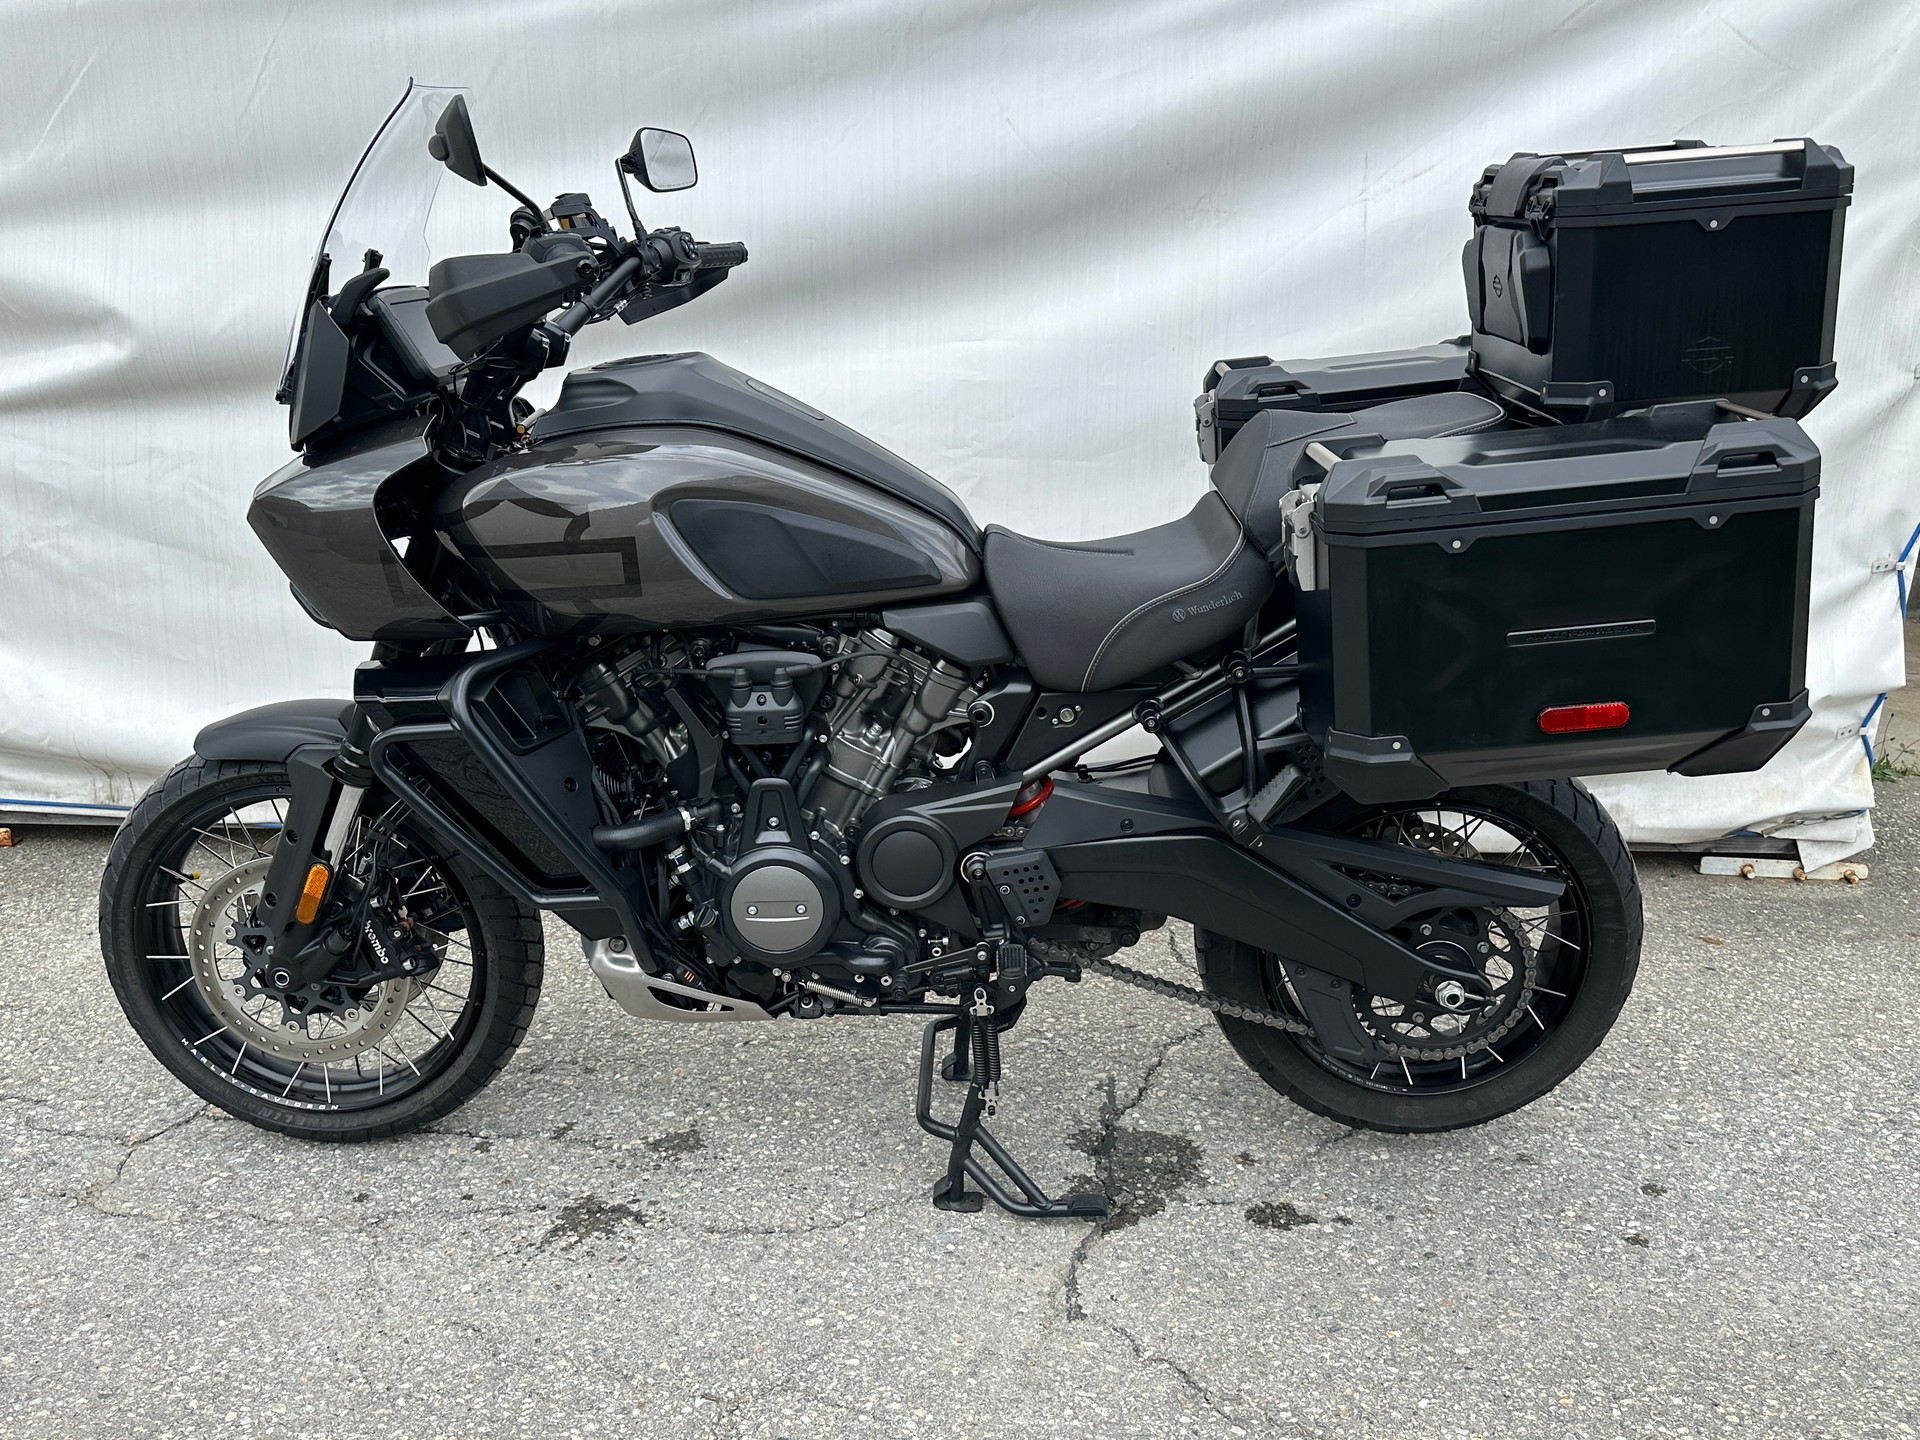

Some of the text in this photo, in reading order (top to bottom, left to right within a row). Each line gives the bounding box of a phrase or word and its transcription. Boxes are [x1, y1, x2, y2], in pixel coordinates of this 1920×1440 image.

[1187, 590, 1243, 616] Wunderlich
[364, 919, 389, 964] brembo
[181, 1037, 339, 1110] HARLEY-DAVIDSON
